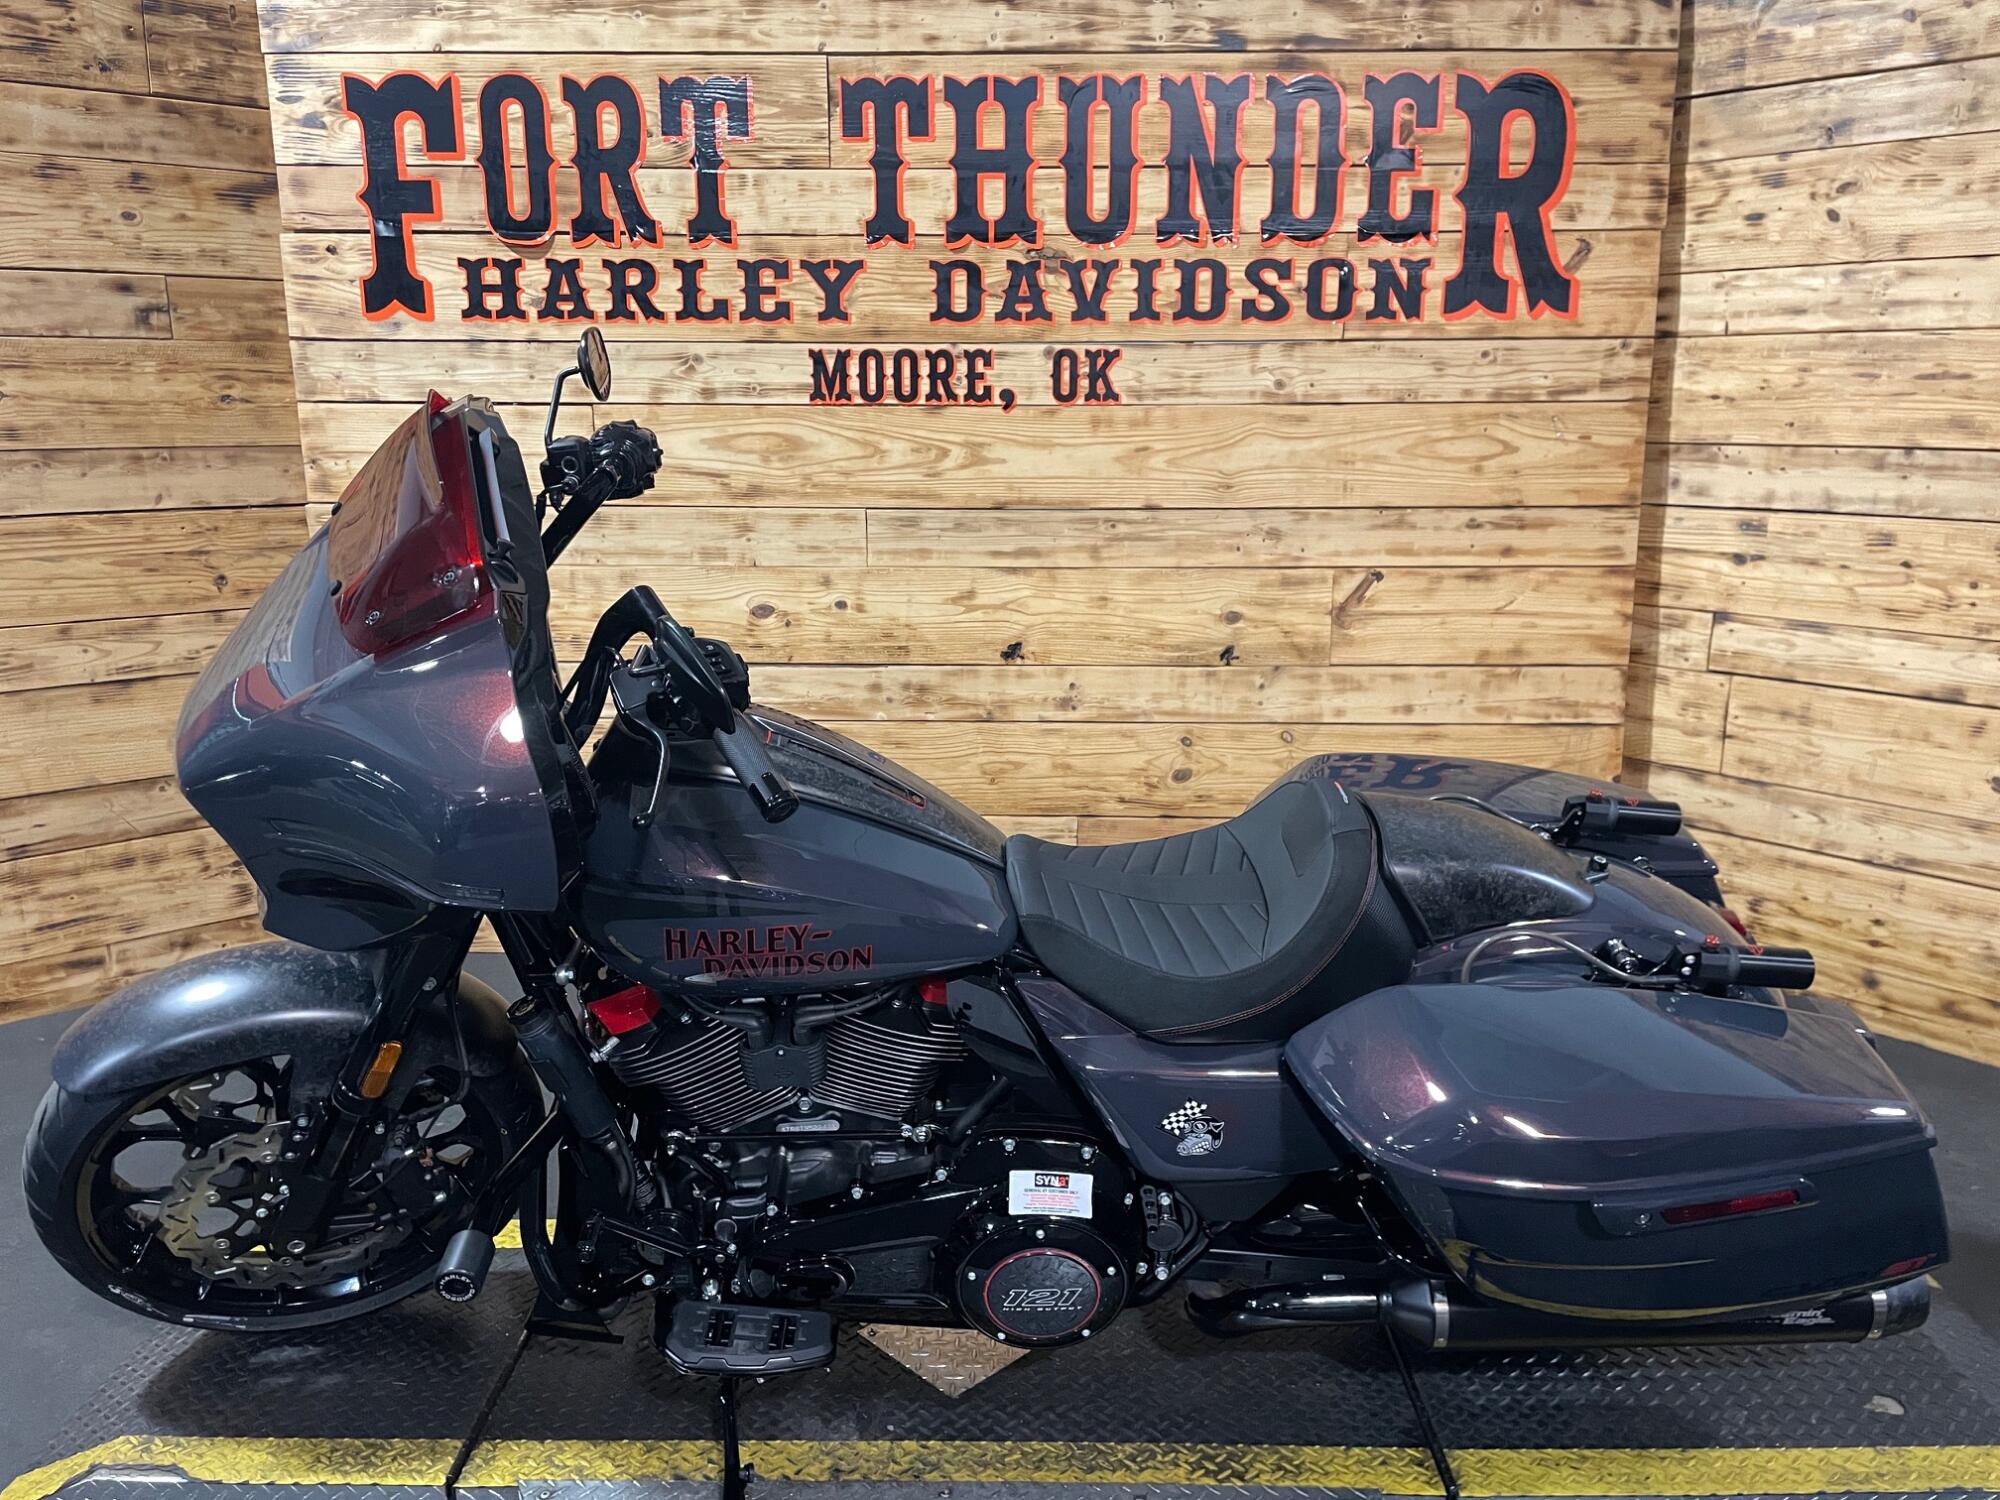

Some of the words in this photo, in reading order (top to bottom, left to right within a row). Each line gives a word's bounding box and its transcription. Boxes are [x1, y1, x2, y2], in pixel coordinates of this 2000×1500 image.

[341, 70, 755, 322] FORT
[839, 68, 1579, 322] THUNDER
[457, 257, 867, 325] HARLEY
[930, 256, 1437, 326] DAVIDSON
[808, 347, 1017, 414] MOORE,
[1050, 347, 1122, 404] OK
[703, 944, 872, 978] DAVIDSON
[1003, 1287, 1083, 1307] 121
